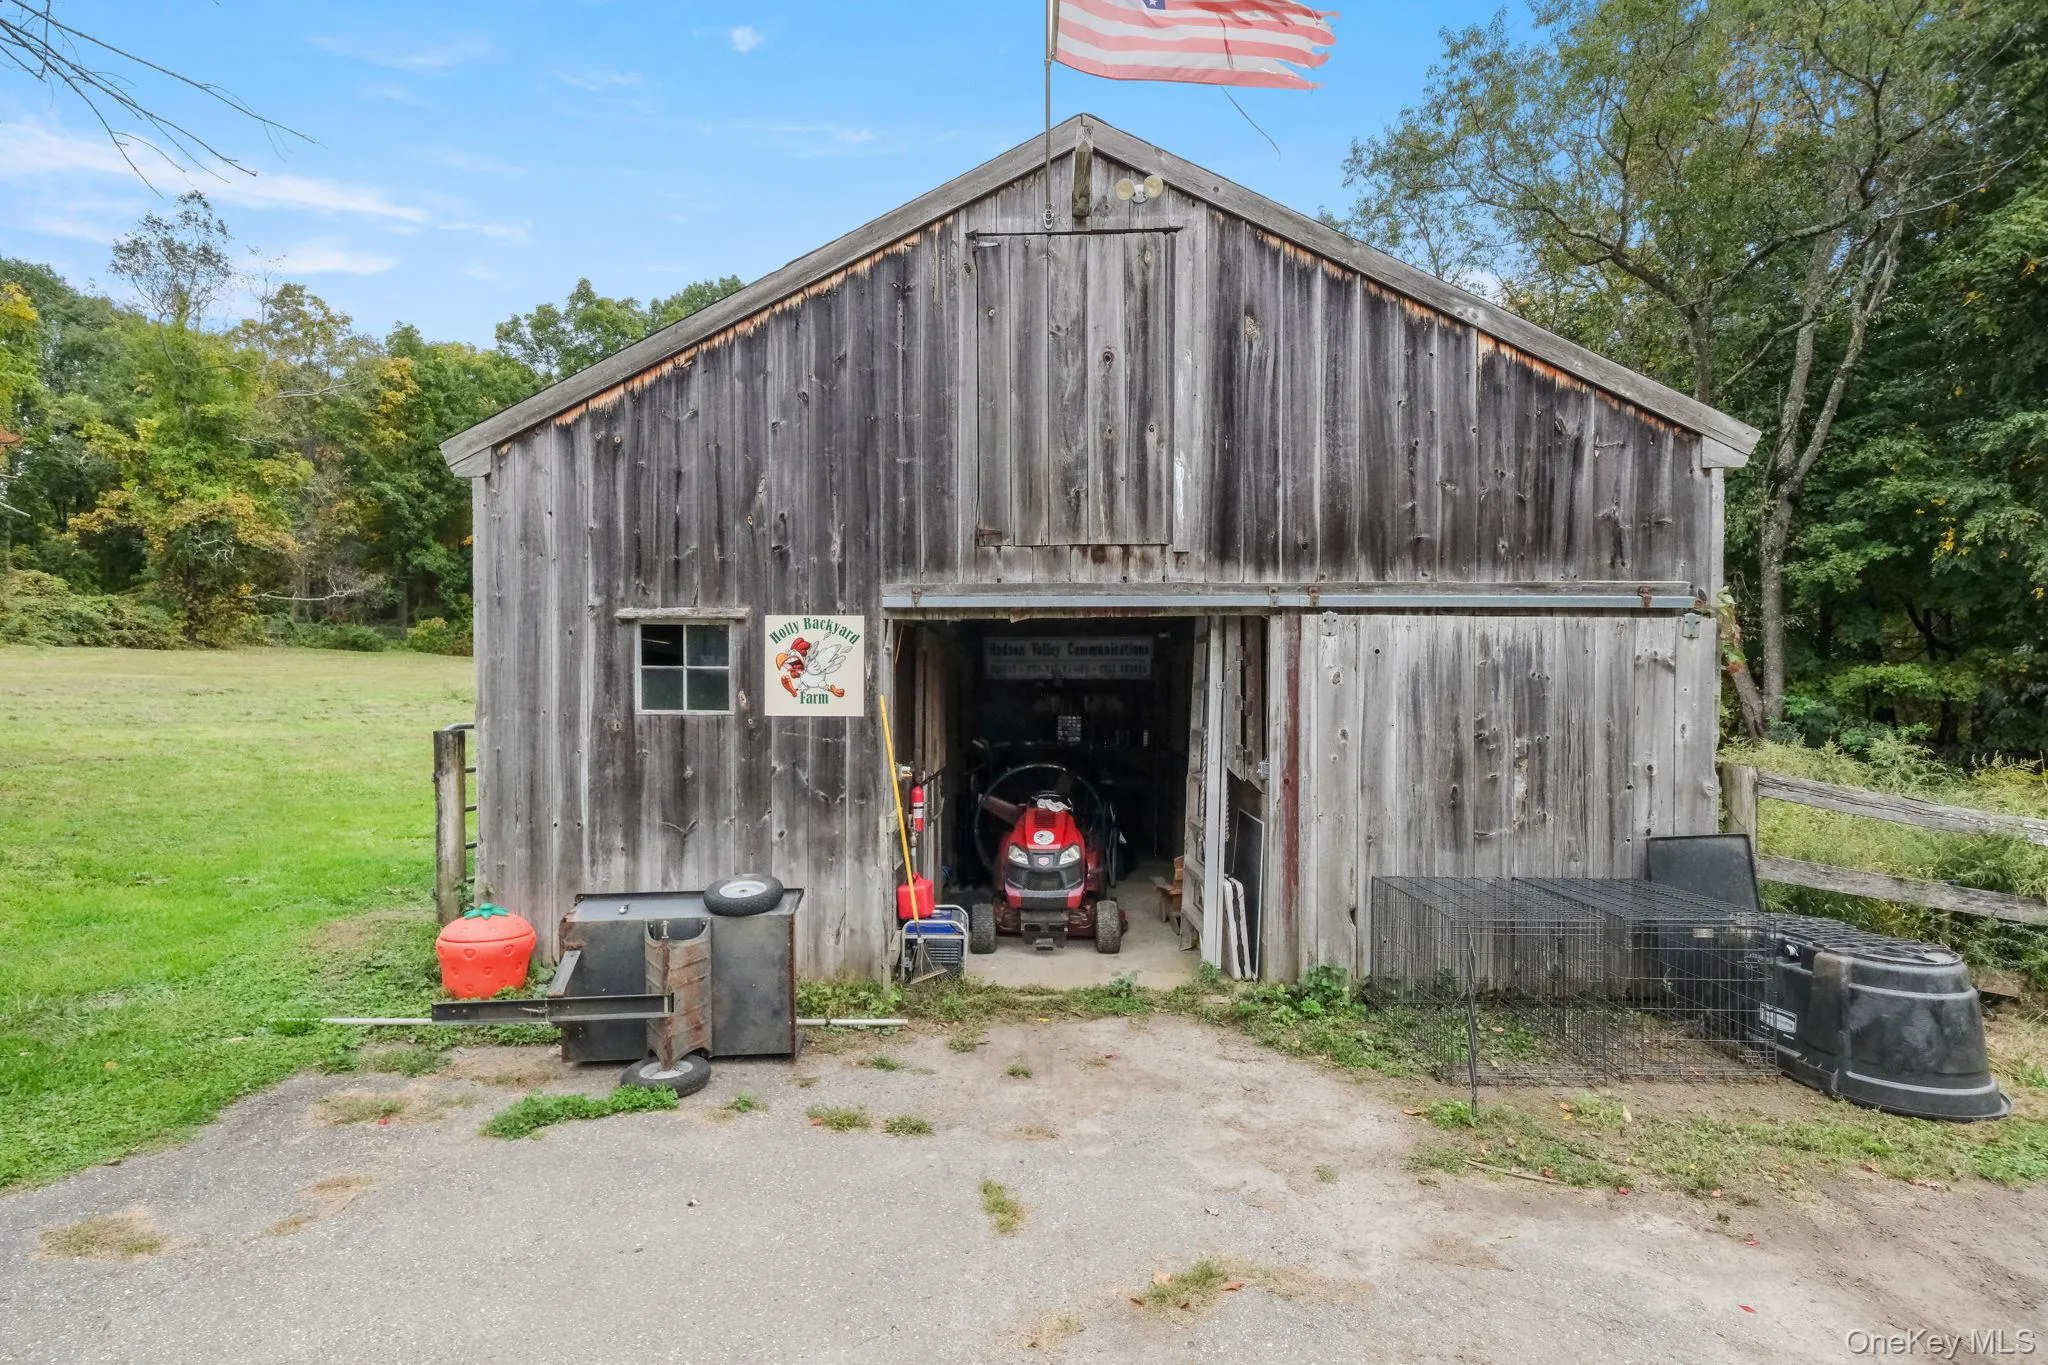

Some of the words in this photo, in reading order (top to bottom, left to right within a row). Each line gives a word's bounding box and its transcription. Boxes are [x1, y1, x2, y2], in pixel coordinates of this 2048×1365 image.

[769, 620, 800, 644] Holly
[803, 617, 861, 645] Backyard
[1032, 642, 1061, 658] Valley
[1067, 642, 1149, 656] Communications
[800, 691, 829, 705] Farm
